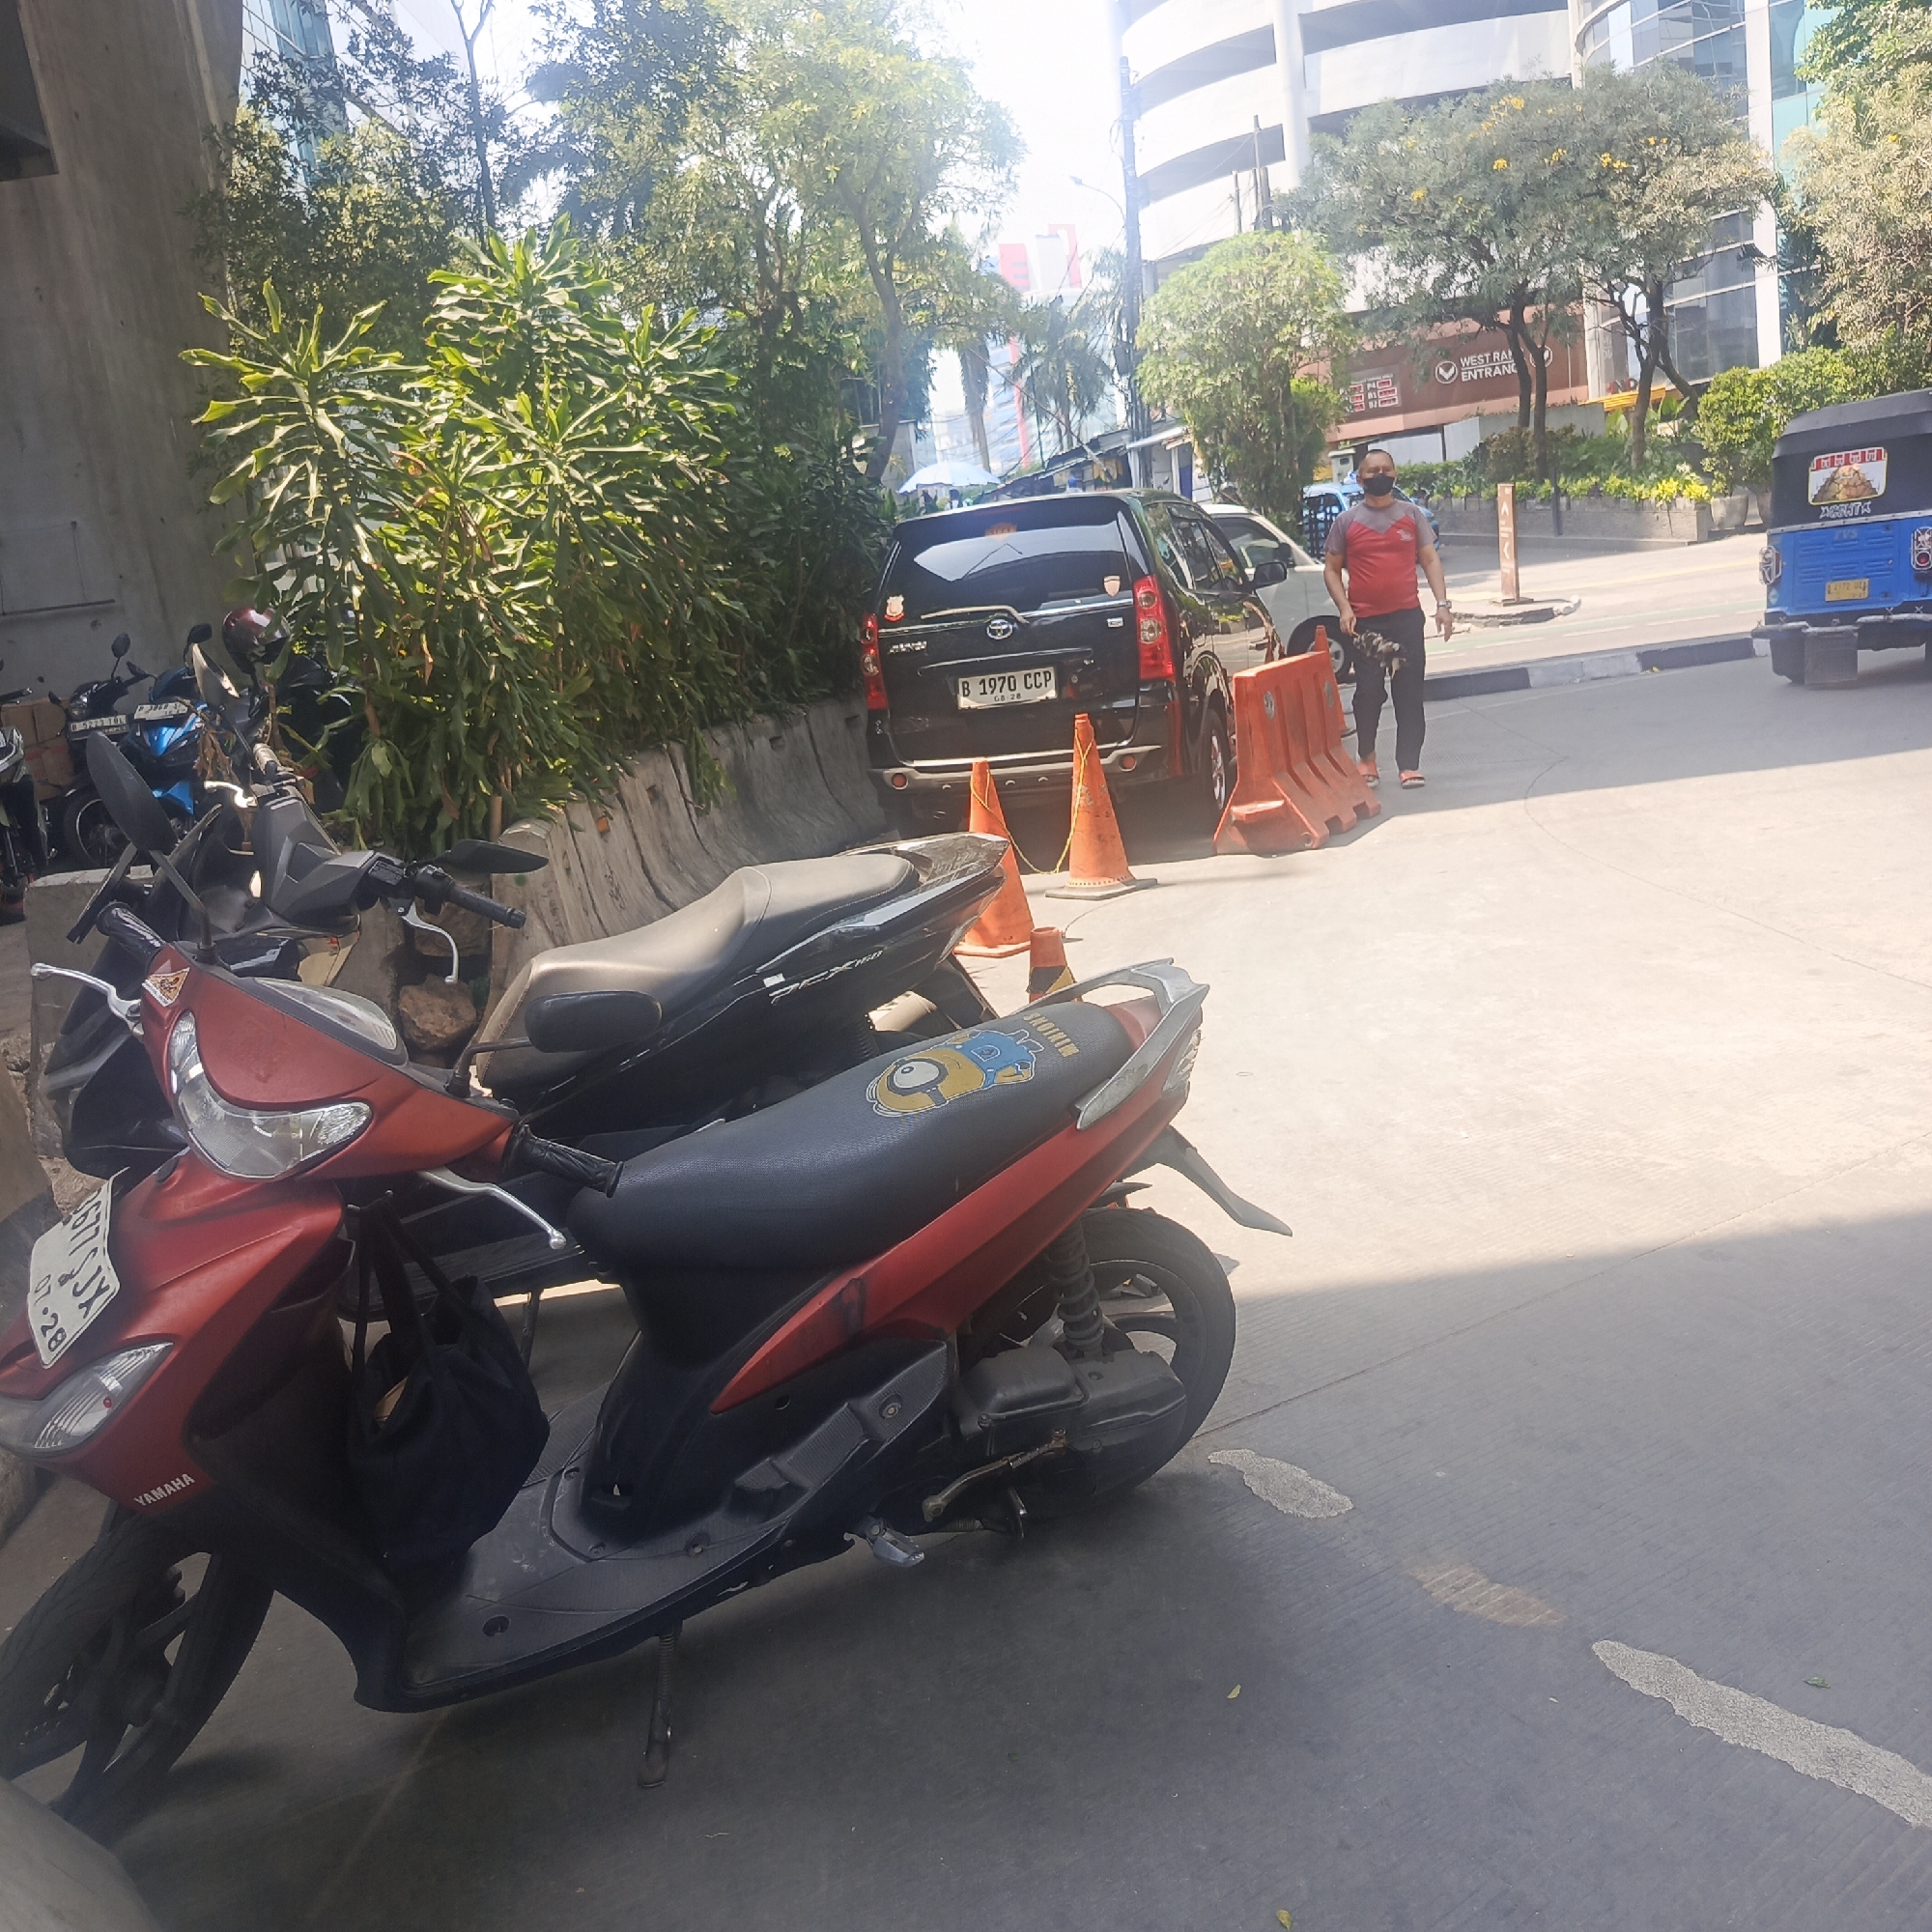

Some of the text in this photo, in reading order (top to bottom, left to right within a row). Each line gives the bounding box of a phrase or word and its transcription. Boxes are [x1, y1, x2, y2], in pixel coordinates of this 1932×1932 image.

[1461, 354, 1492, 367] WEST
[1461, 363, 1519, 383] ENTRANC
[961, 670, 1052, 697] B 1970 CCP
[1023, 1012, 1080, 1058] MINIONS
[133, 1473, 196, 1506] YAMAHA
